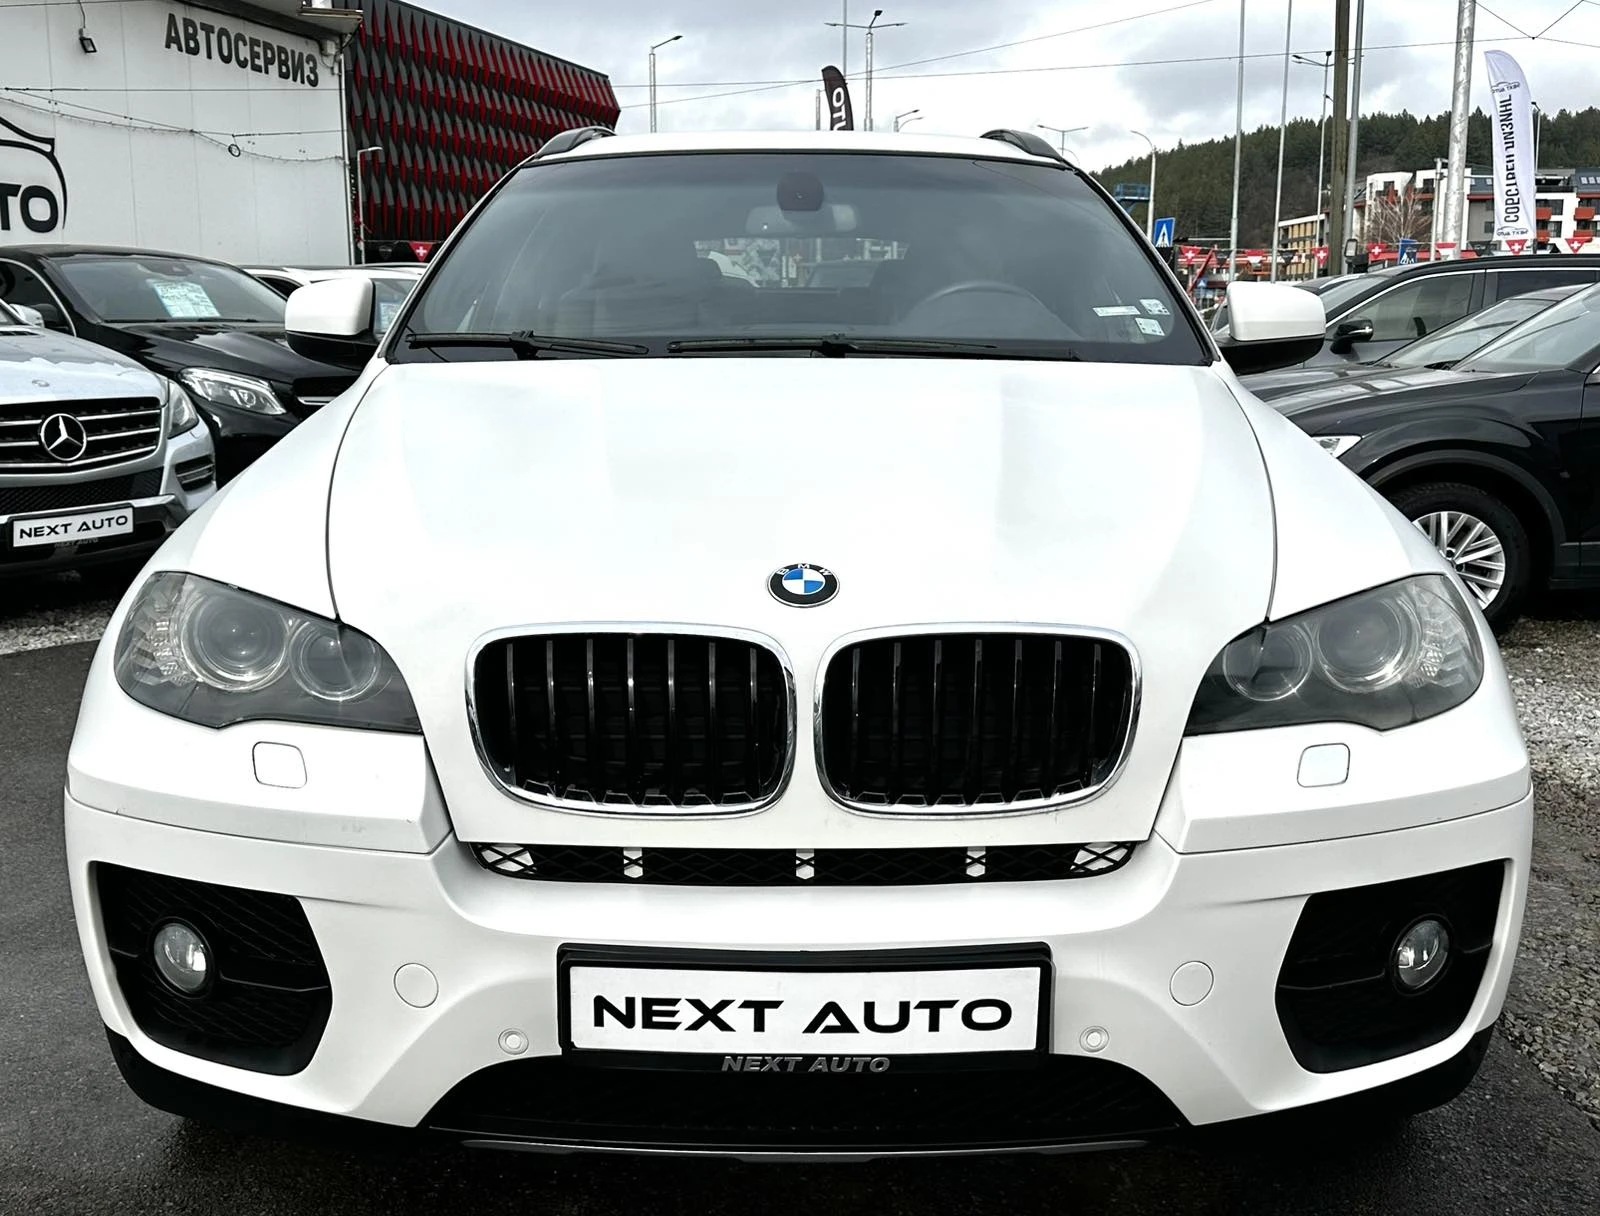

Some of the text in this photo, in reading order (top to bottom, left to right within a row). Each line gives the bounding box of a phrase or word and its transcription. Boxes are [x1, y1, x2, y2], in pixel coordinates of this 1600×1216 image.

[165, 13, 319, 87] АВТОСЕРВИЗ
[20, 515, 128, 539] NEXT AUTO
[593, 995, 1012, 1034] NEXT AUTO
[721, 1056, 891, 1073] NEXT AUTO
